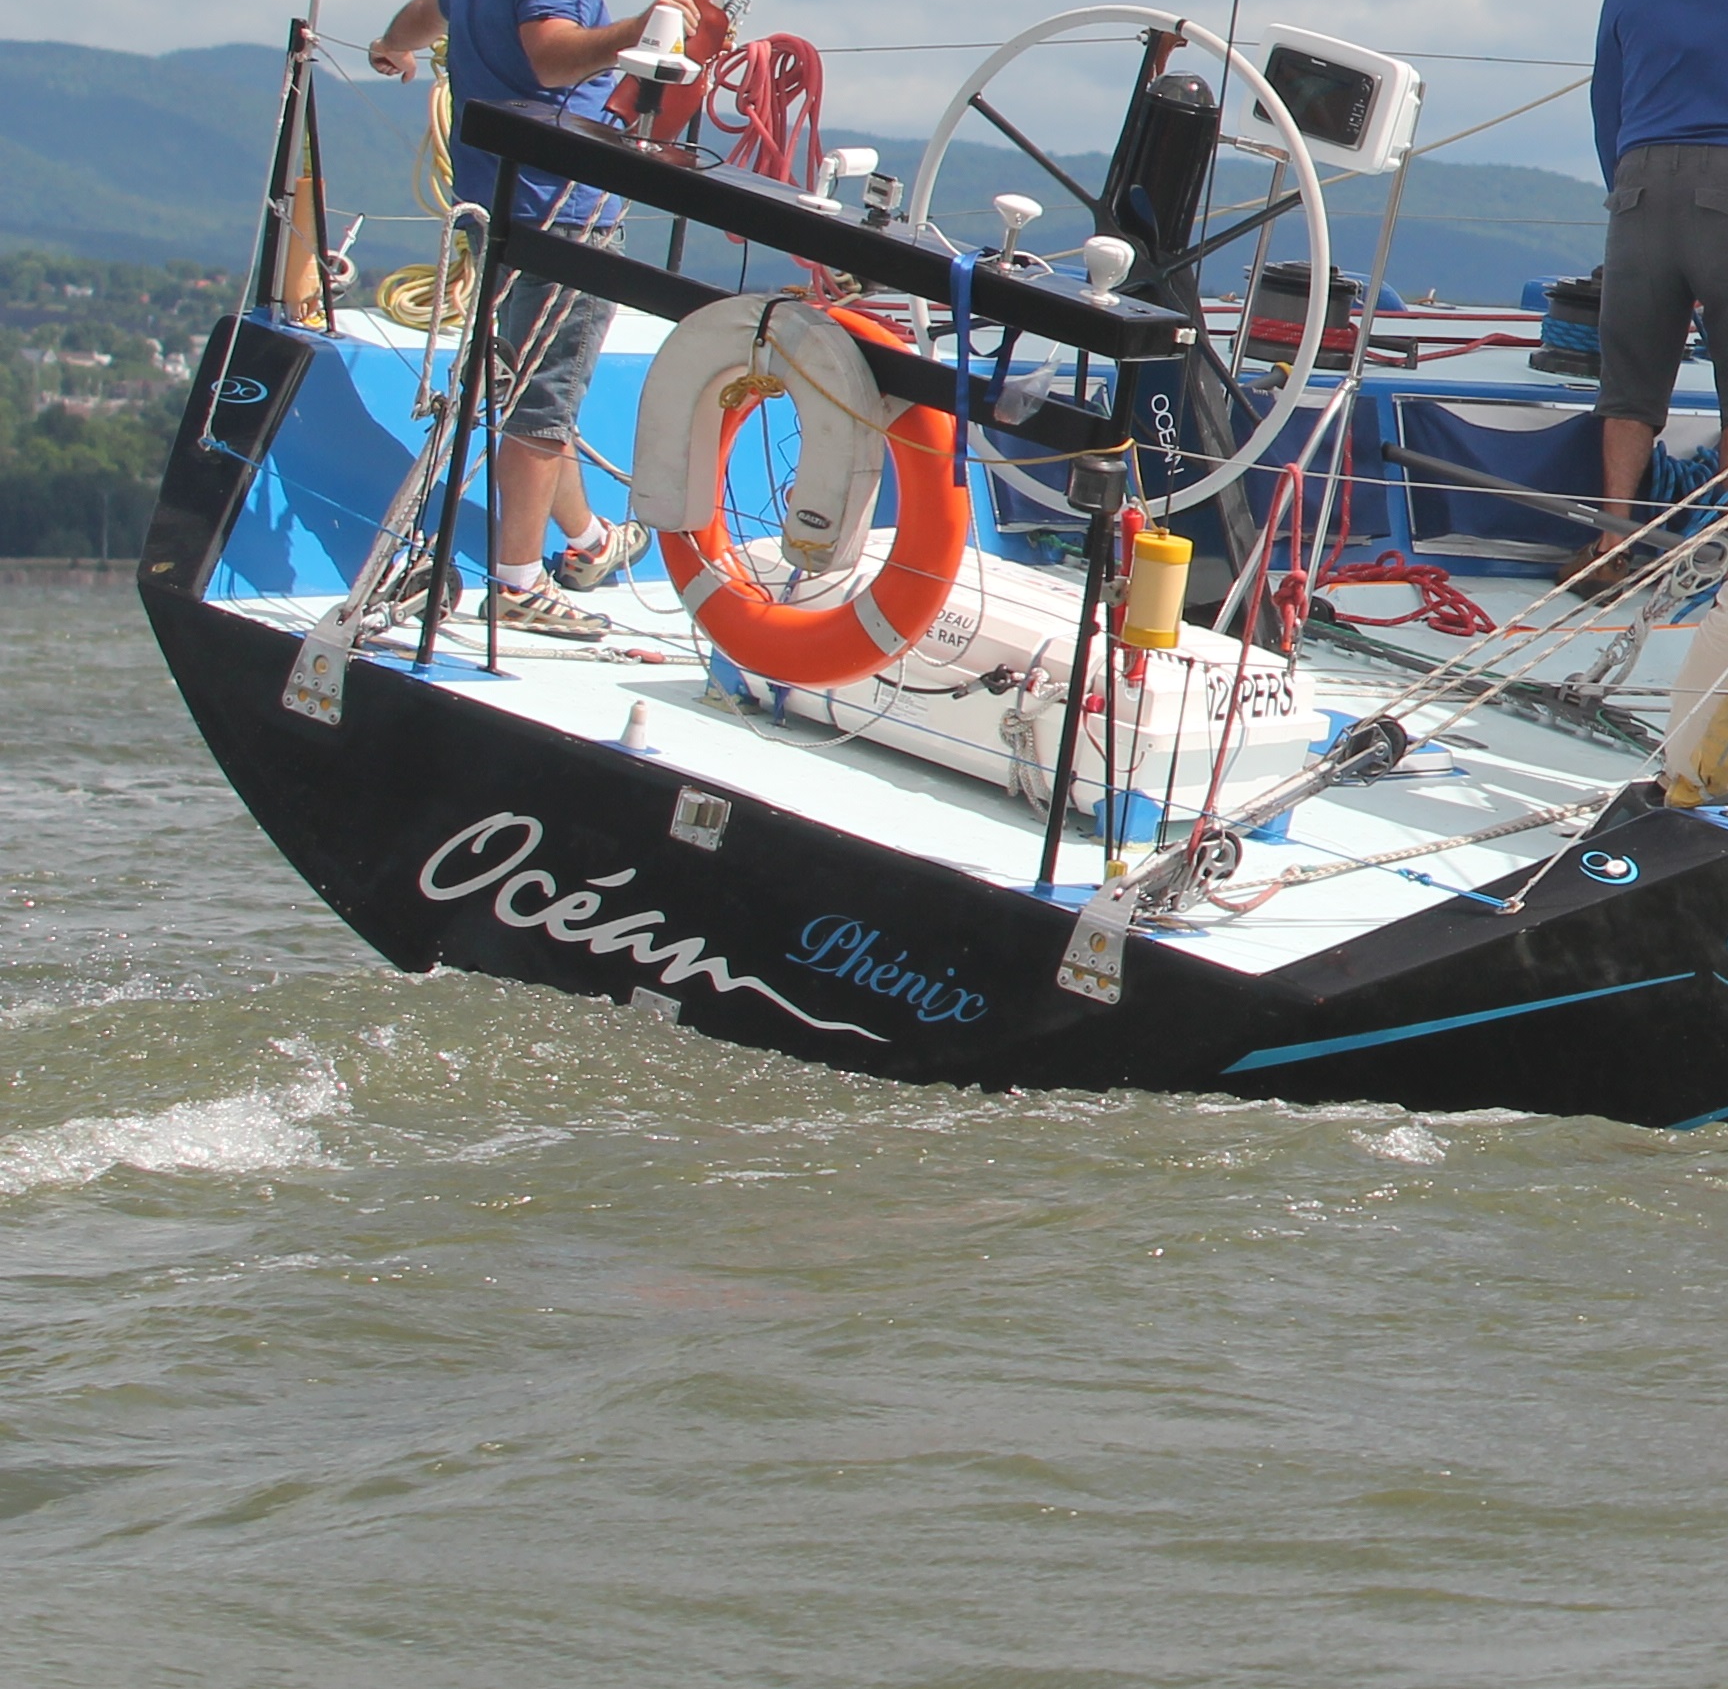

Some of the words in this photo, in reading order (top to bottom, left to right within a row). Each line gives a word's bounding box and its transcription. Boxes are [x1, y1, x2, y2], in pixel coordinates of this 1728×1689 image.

[936, 608, 975, 630] DEAU
[419, 812, 891, 1042] Océan
[785, 914, 990, 1023] Phénix
